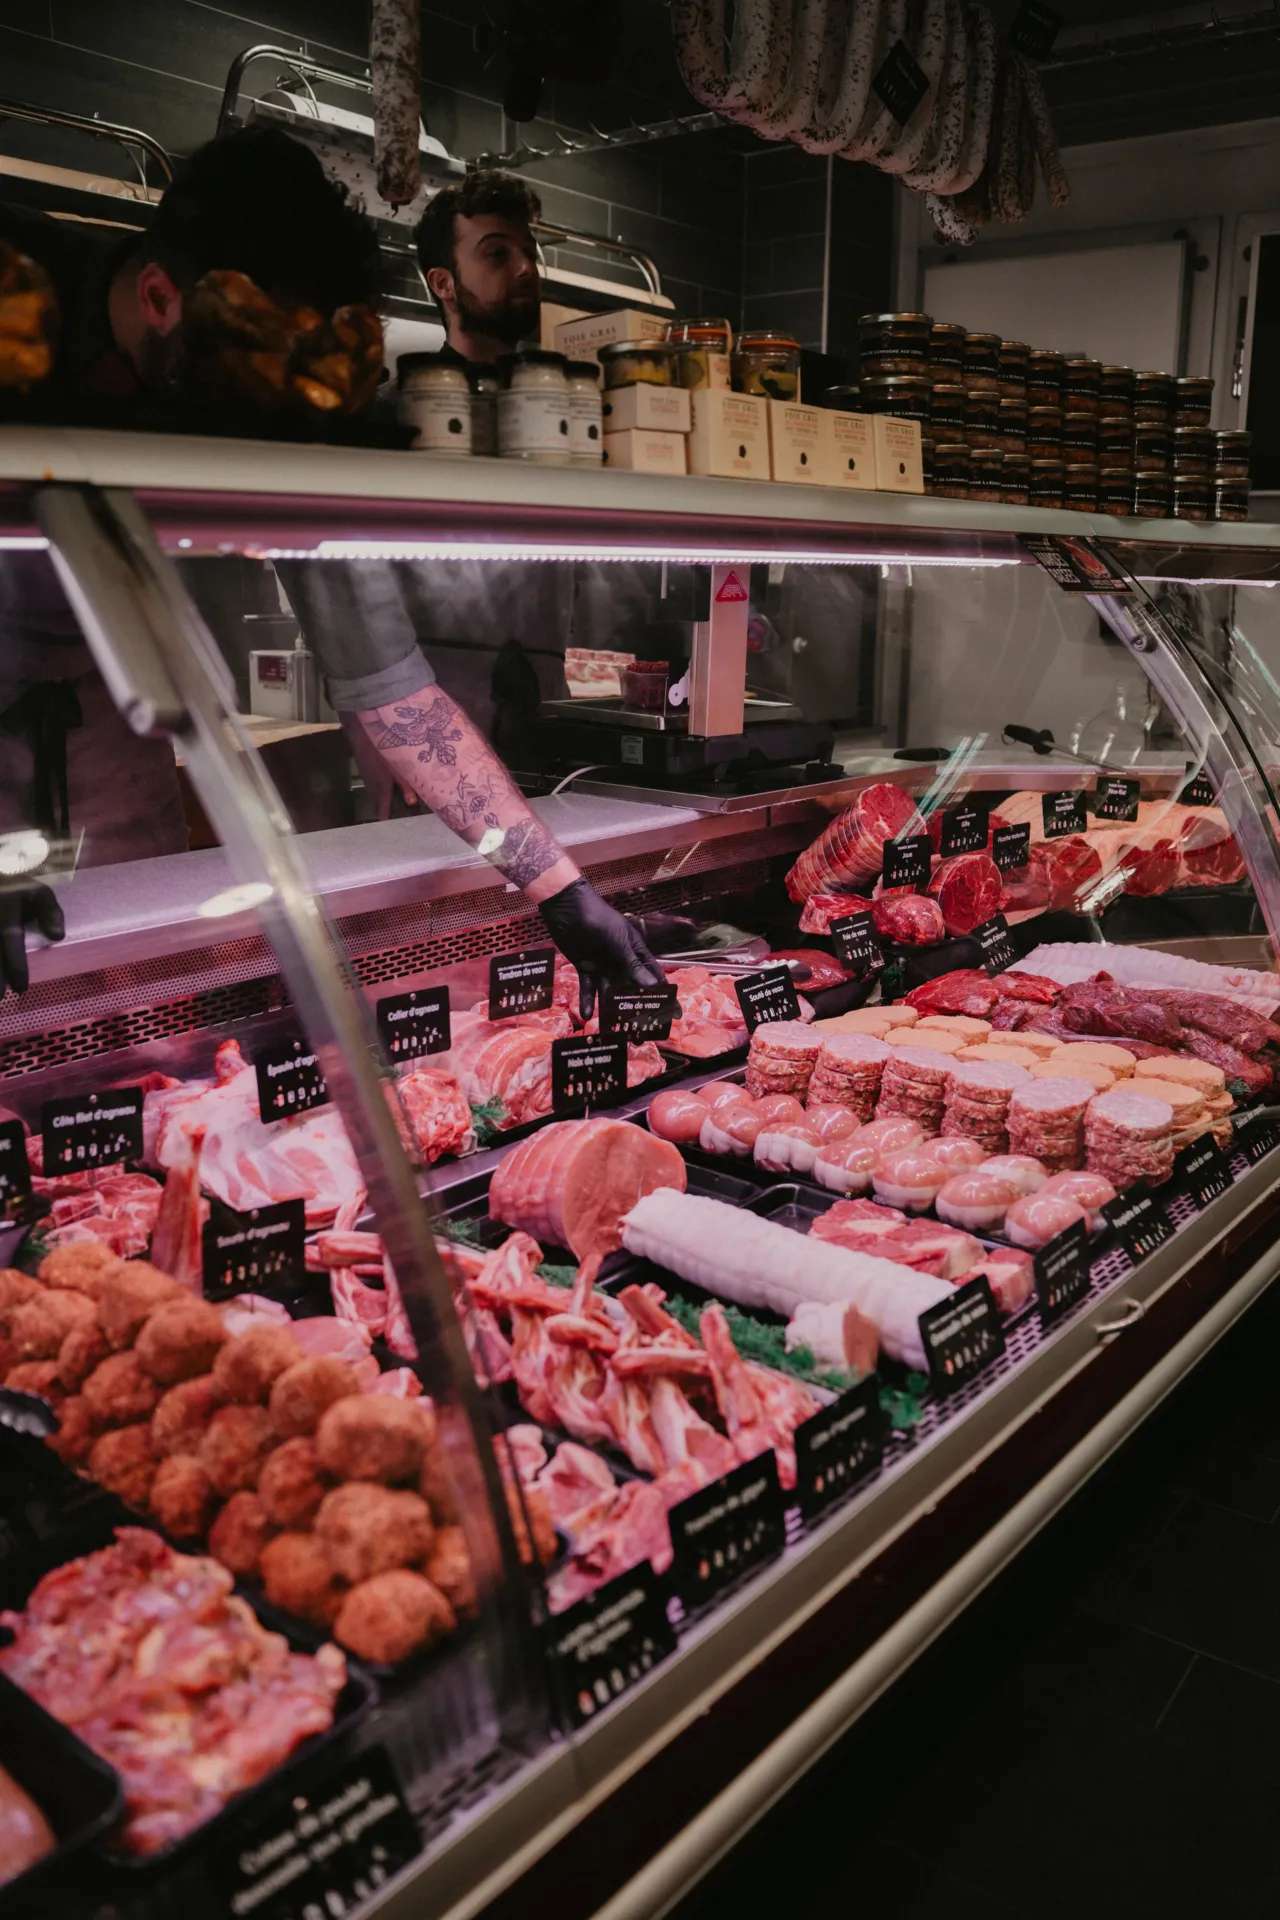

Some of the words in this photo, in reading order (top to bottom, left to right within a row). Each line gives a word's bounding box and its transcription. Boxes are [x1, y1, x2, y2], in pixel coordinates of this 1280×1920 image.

[590, 326, 616, 339] GRAS
[851, 930, 858, 939] de
[857, 928, 868, 937] veau
[498, 967, 522, 981] Tendron
[522, 967, 531, 978] de
[531, 966, 547, 977] veau
[749, 990, 765, 1003] Sauté
[764, 988, 772, 997] de
[772, 985, 784, 995] veau
[387, 1009, 409, 1022] Collier
[409, 1003, 440, 1017] d'agneau
[618, 1002, 634, 1010] Côte
[567, 1057, 584, 1068] Noix
[584, 1056, 594, 1066] de
[594, 1054, 612, 1065] veau
[52, 1115, 75, 1128] Côte
[75, 1110, 93, 1124] filet
[93, 1105, 137, 1121] d'agneau
[1132, 1203, 1141, 1215] de
[1140, 1197, 1152, 1210] veau
[246, 1220, 291, 1241] d'agneau
[971, 1303, 989, 1320] veau
